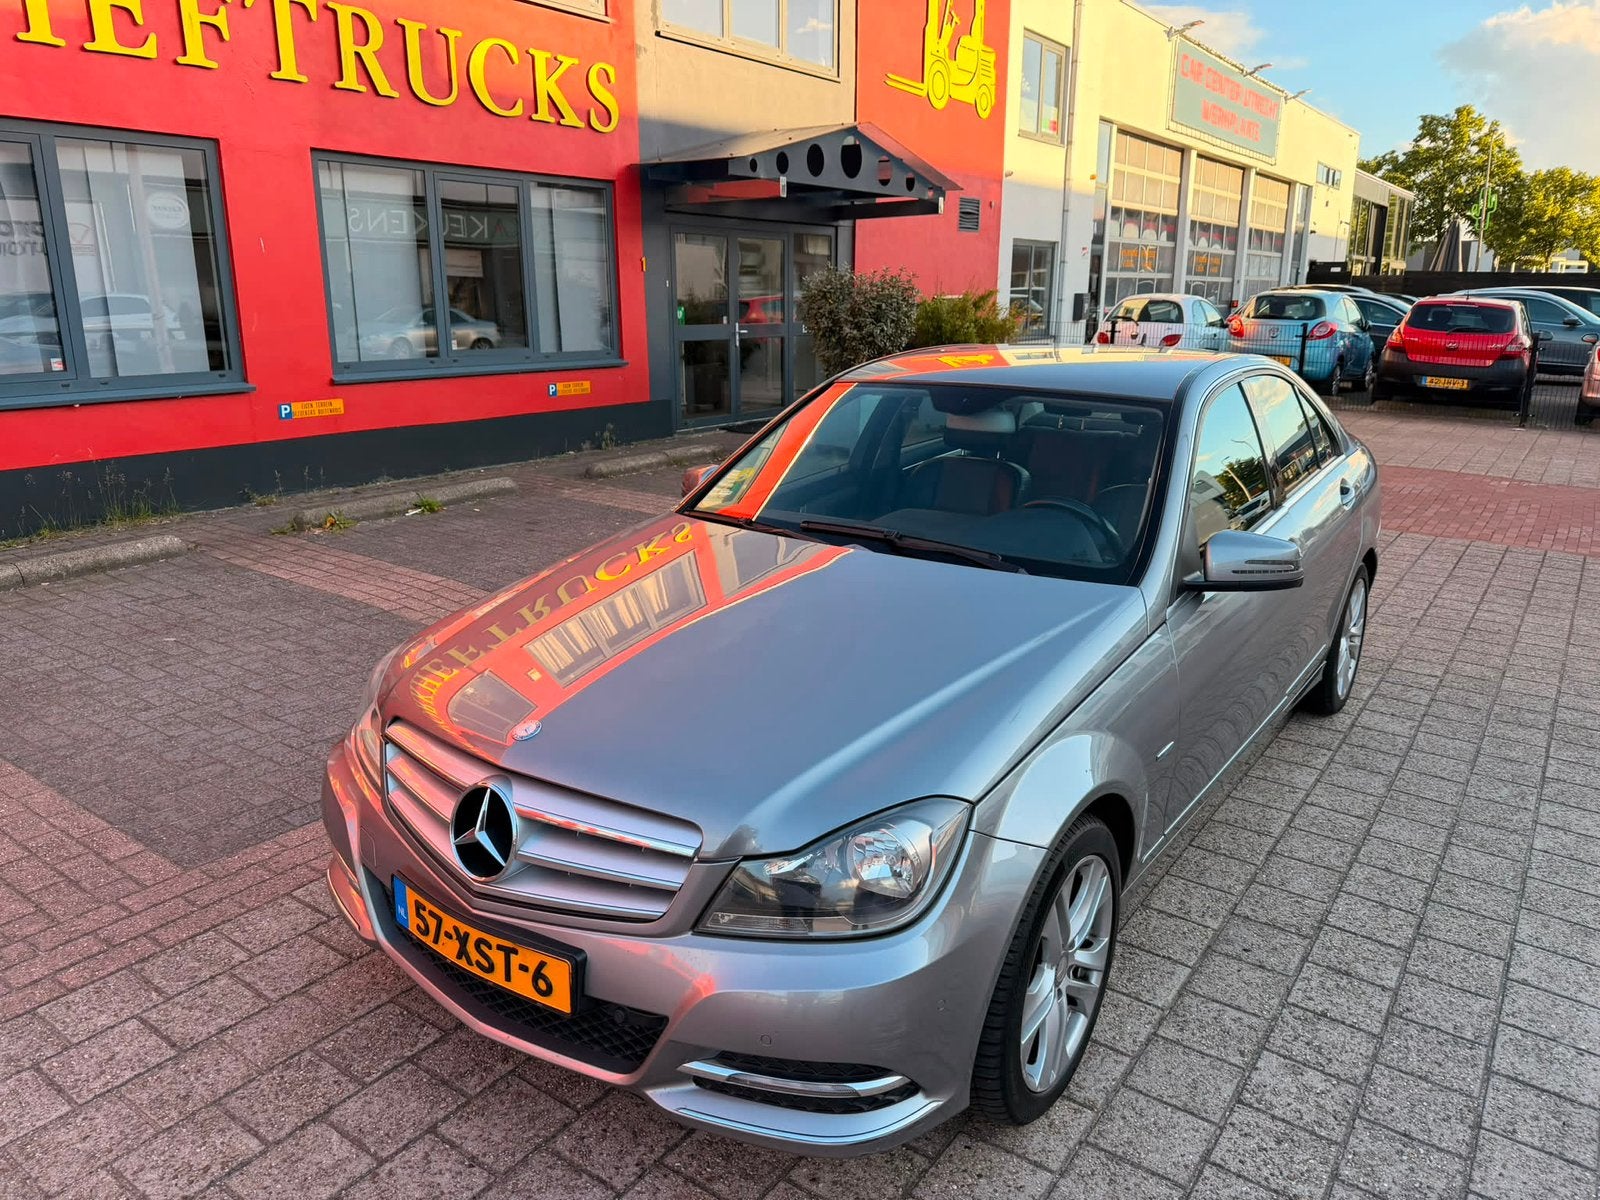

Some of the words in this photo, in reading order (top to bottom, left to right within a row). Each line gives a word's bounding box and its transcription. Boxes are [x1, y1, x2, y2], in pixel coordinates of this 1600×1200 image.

[13, 0, 618, 134] EFTRUCKS
[1181, 53, 1204, 85] CAR
[280, 404, 290, 418] P
[414, 898, 553, 998] 57-XST-6
